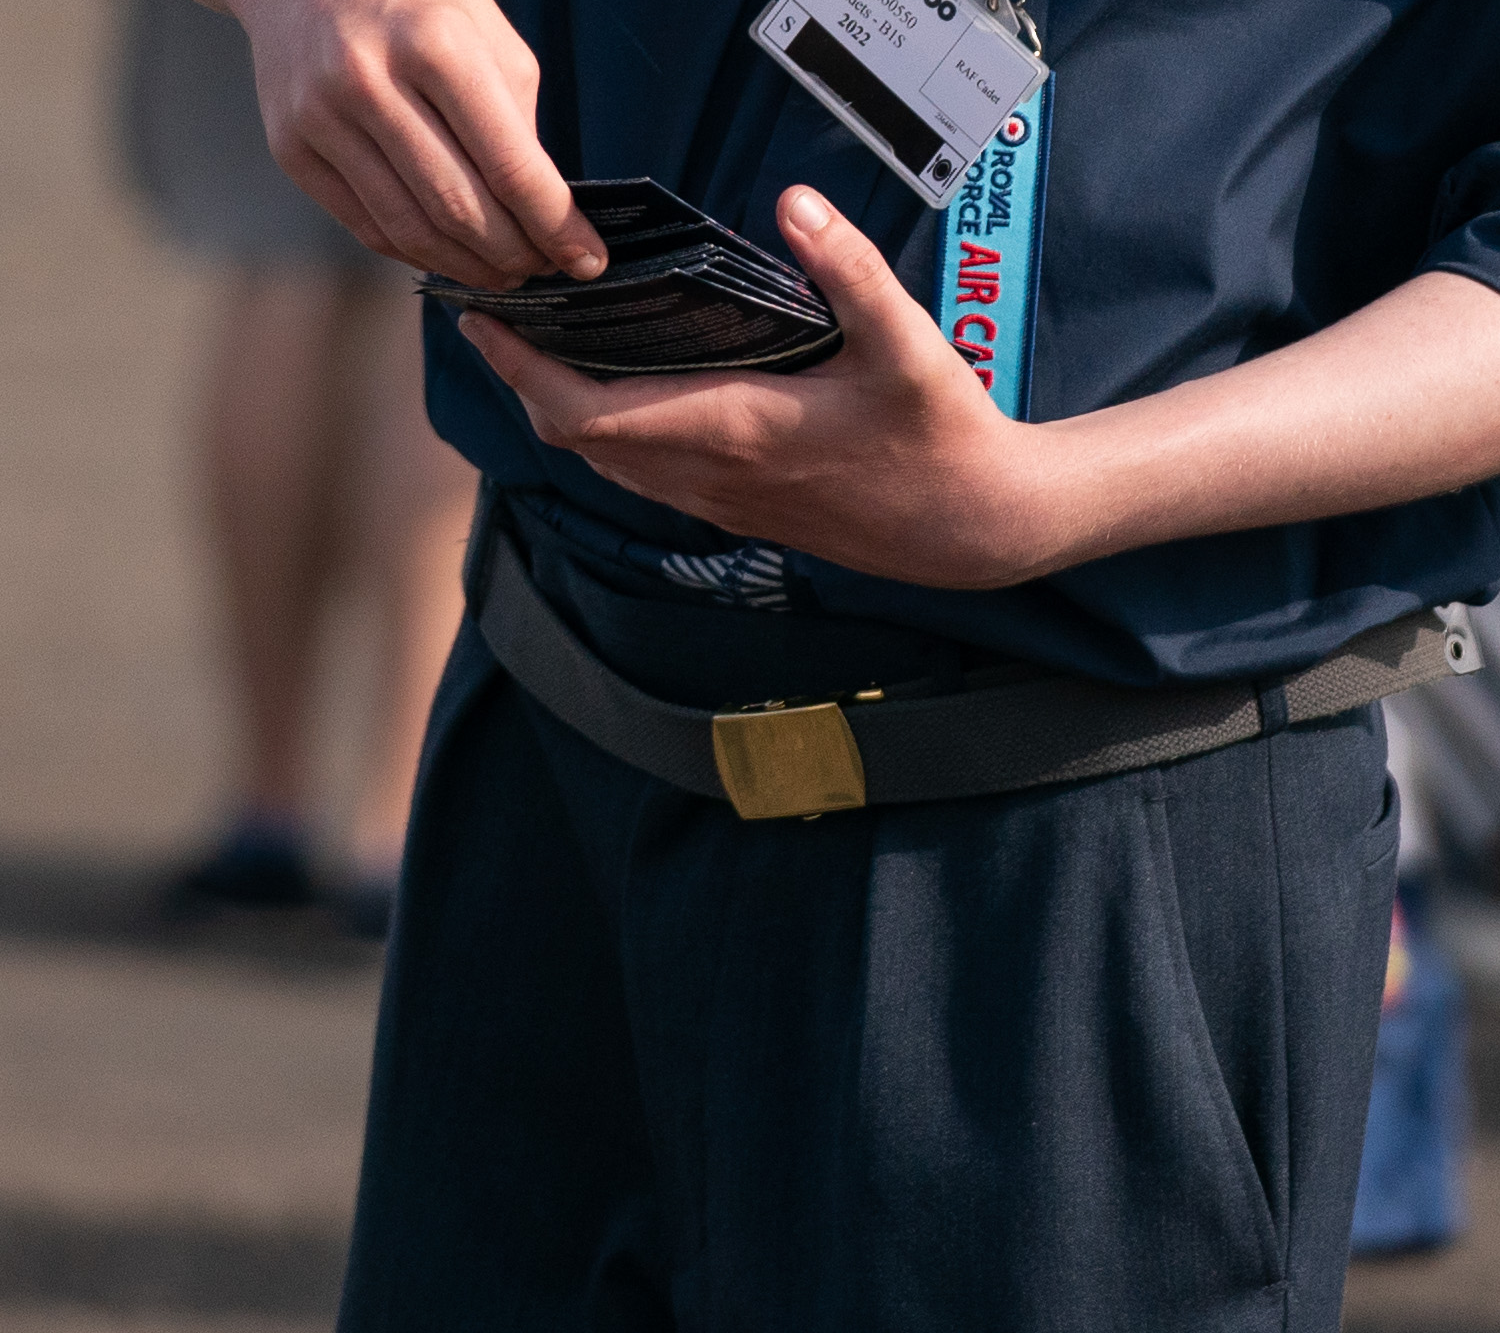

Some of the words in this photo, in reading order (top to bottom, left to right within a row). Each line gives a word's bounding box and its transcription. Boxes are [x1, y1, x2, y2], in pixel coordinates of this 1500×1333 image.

[780, 15, 796, 33] S
[837, 13, 871, 47] 2022
[955, 59, 979, 81] RAF
[976, 79, 1001, 105] Cadet
[986, 149, 1017, 235] ROYAL
[956, 241, 1002, 304] AIR
